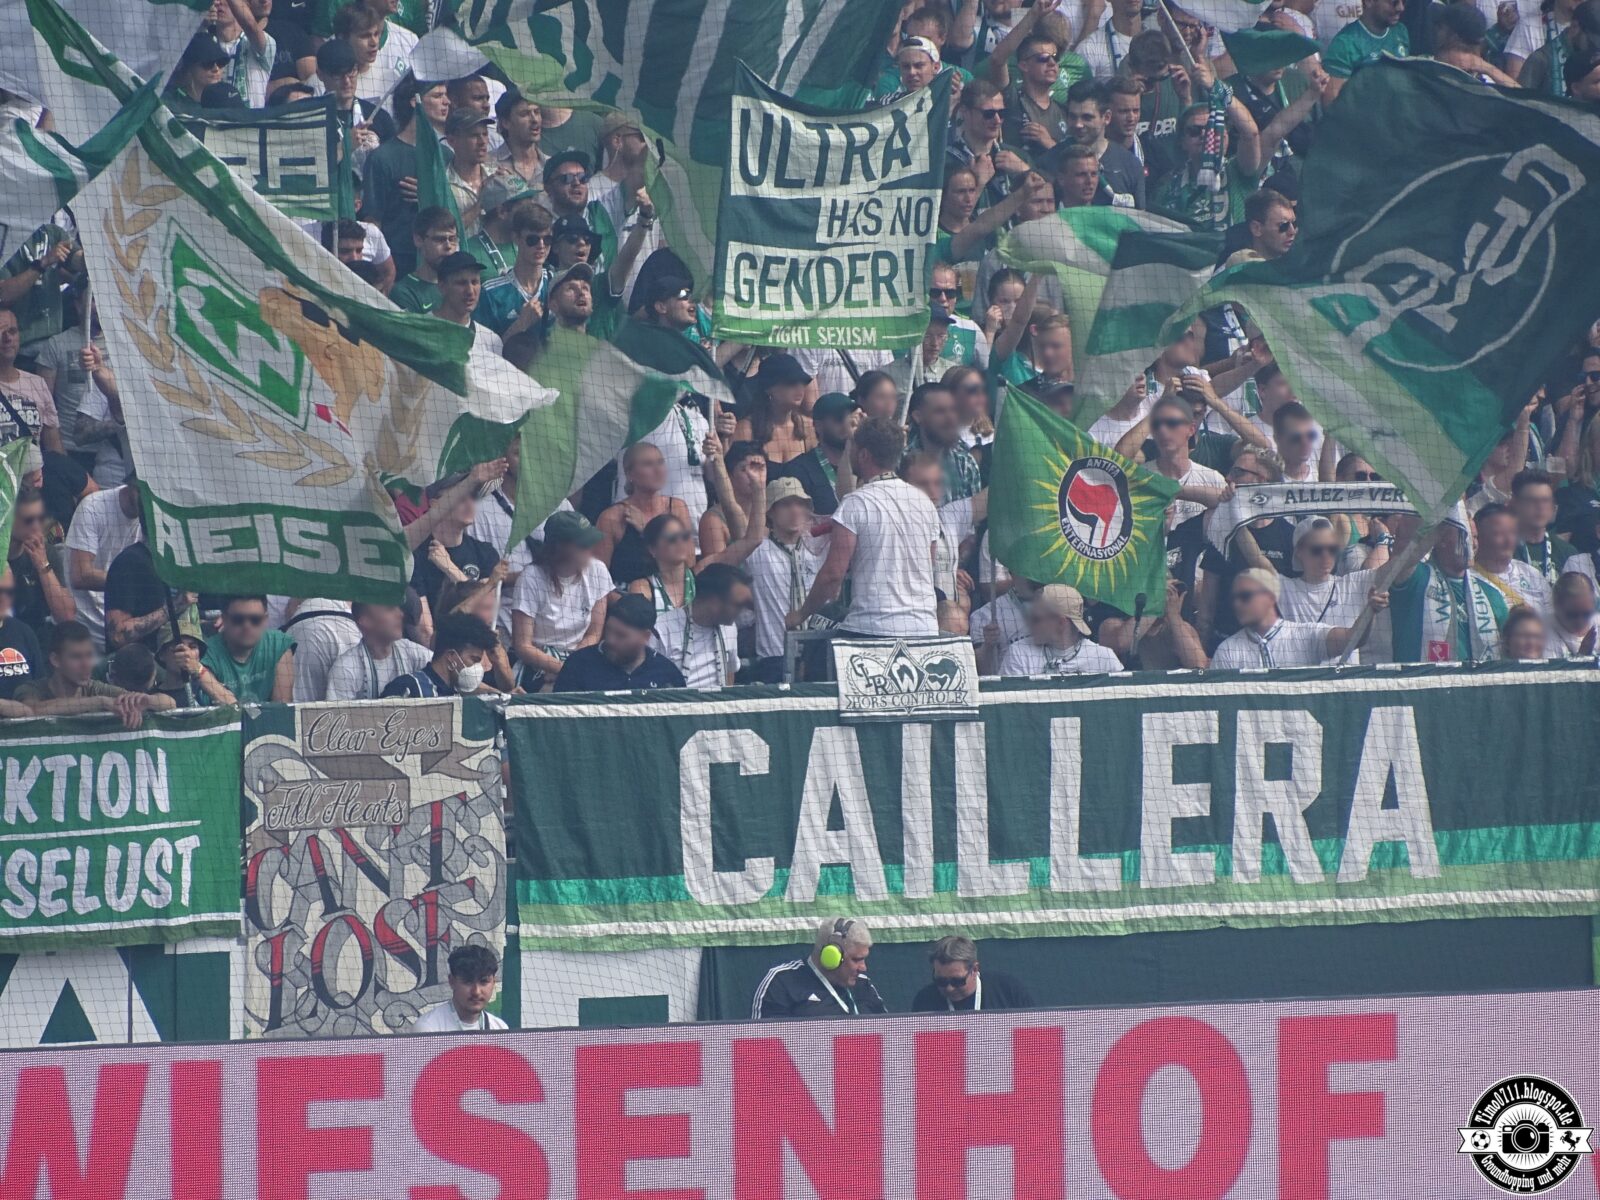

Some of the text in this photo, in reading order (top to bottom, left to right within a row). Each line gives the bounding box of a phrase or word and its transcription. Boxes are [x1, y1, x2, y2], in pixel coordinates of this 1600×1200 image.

[827, 196, 934, 237] HAS NO
[733, 248, 916, 311] GENDER!
[816, 325, 877, 346] SEXISM
[1086, 459, 1121, 478] ANTIFA
[1284, 488, 1345, 505] ALLEZ
[1061, 517, 1128, 559] ENTERNASYONAL
[852, 691, 963, 710] HORS CONTROLE
[304, 709, 444, 763] Clear Eyes
[0, 747, 170, 825] KTION
[266, 780, 407, 829] Full Hearts
[680, 705, 1442, 905] CAILLERA
[0, 835, 200, 919] SELUST
